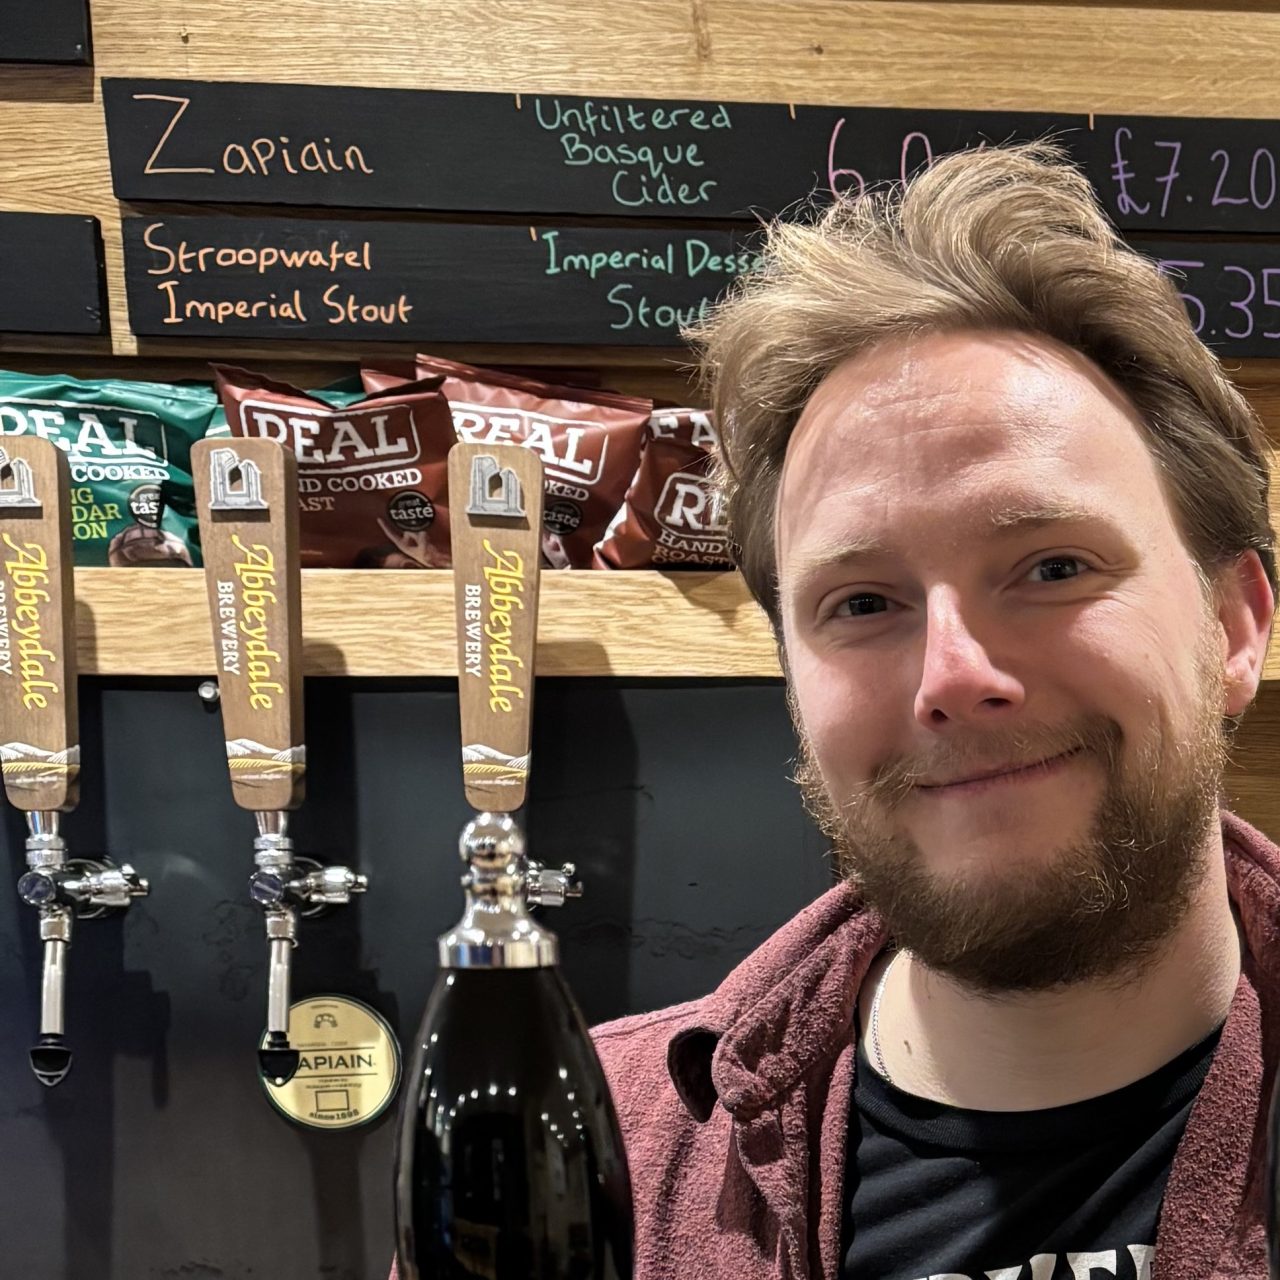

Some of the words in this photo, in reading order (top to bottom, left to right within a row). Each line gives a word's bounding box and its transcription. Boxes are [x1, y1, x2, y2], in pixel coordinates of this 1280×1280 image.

[132, 94, 374, 176] Zapiain
[534, 98, 732, 133] Unfiltered
[563, 135, 705, 176] Basque
[1111, 127, 1277, 217] £7.20
[611, 172, 718, 206] Cider
[143, 223, 372, 275] Stroopwafel
[541, 230, 675, 279] Imperial
[158, 280, 306, 323] Imperial
[322, 284, 414, 324] Stout
[451, 409, 593, 475] REAL
[71, 464, 171, 482] COOKED
[327, 468, 423, 493] COOKED
[389, 504, 435, 521] taste
[657, 529, 724, 554] HAND
[3, 533, 59, 710] Abbeydale
[216, 580, 240, 676] BREWERY
[232, 535, 285, 711] Abbeydale
[464, 584, 482, 678] BREWERY
[483, 539, 525, 714] Abbeydale
